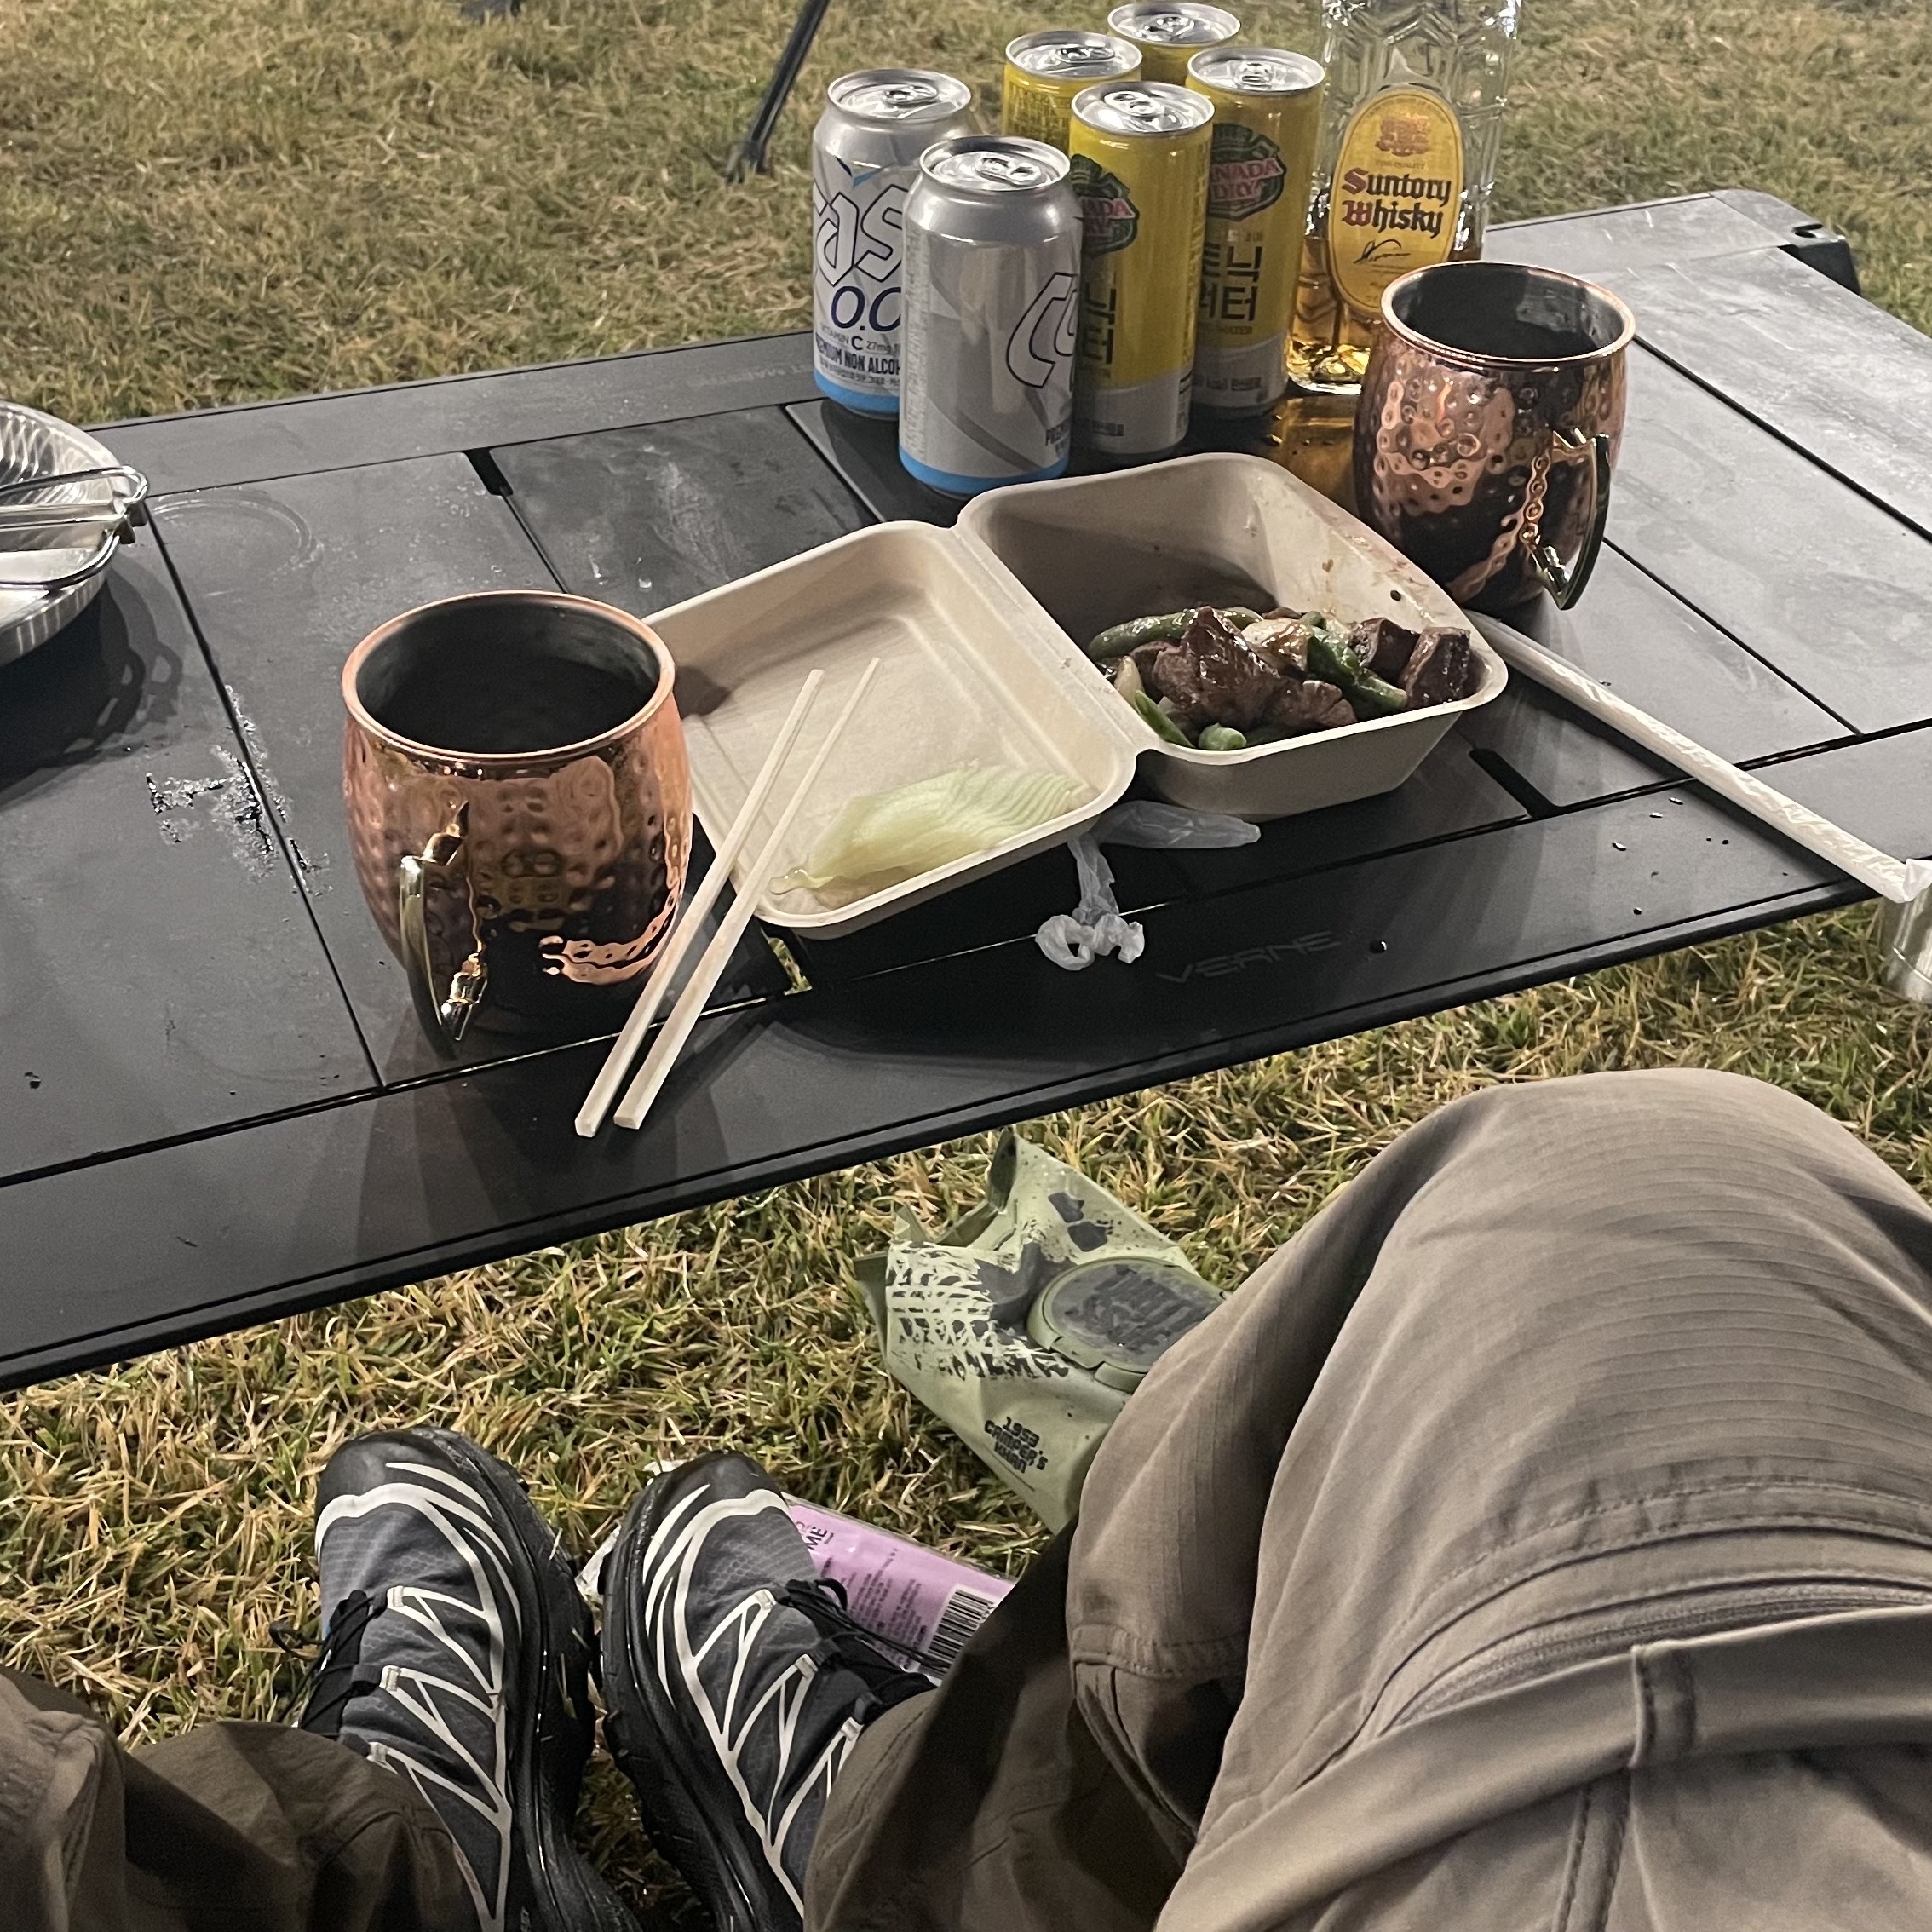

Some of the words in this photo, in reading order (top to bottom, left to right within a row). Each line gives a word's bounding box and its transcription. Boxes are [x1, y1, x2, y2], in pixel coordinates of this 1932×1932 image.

[1342, 168, 1451, 208] Suntory
[1342, 199, 1443, 239] Whisky
[852, 336, 863, 350] C
[844, 350, 865, 372] NON
[1003, 1416, 1040, 1448] 1953
